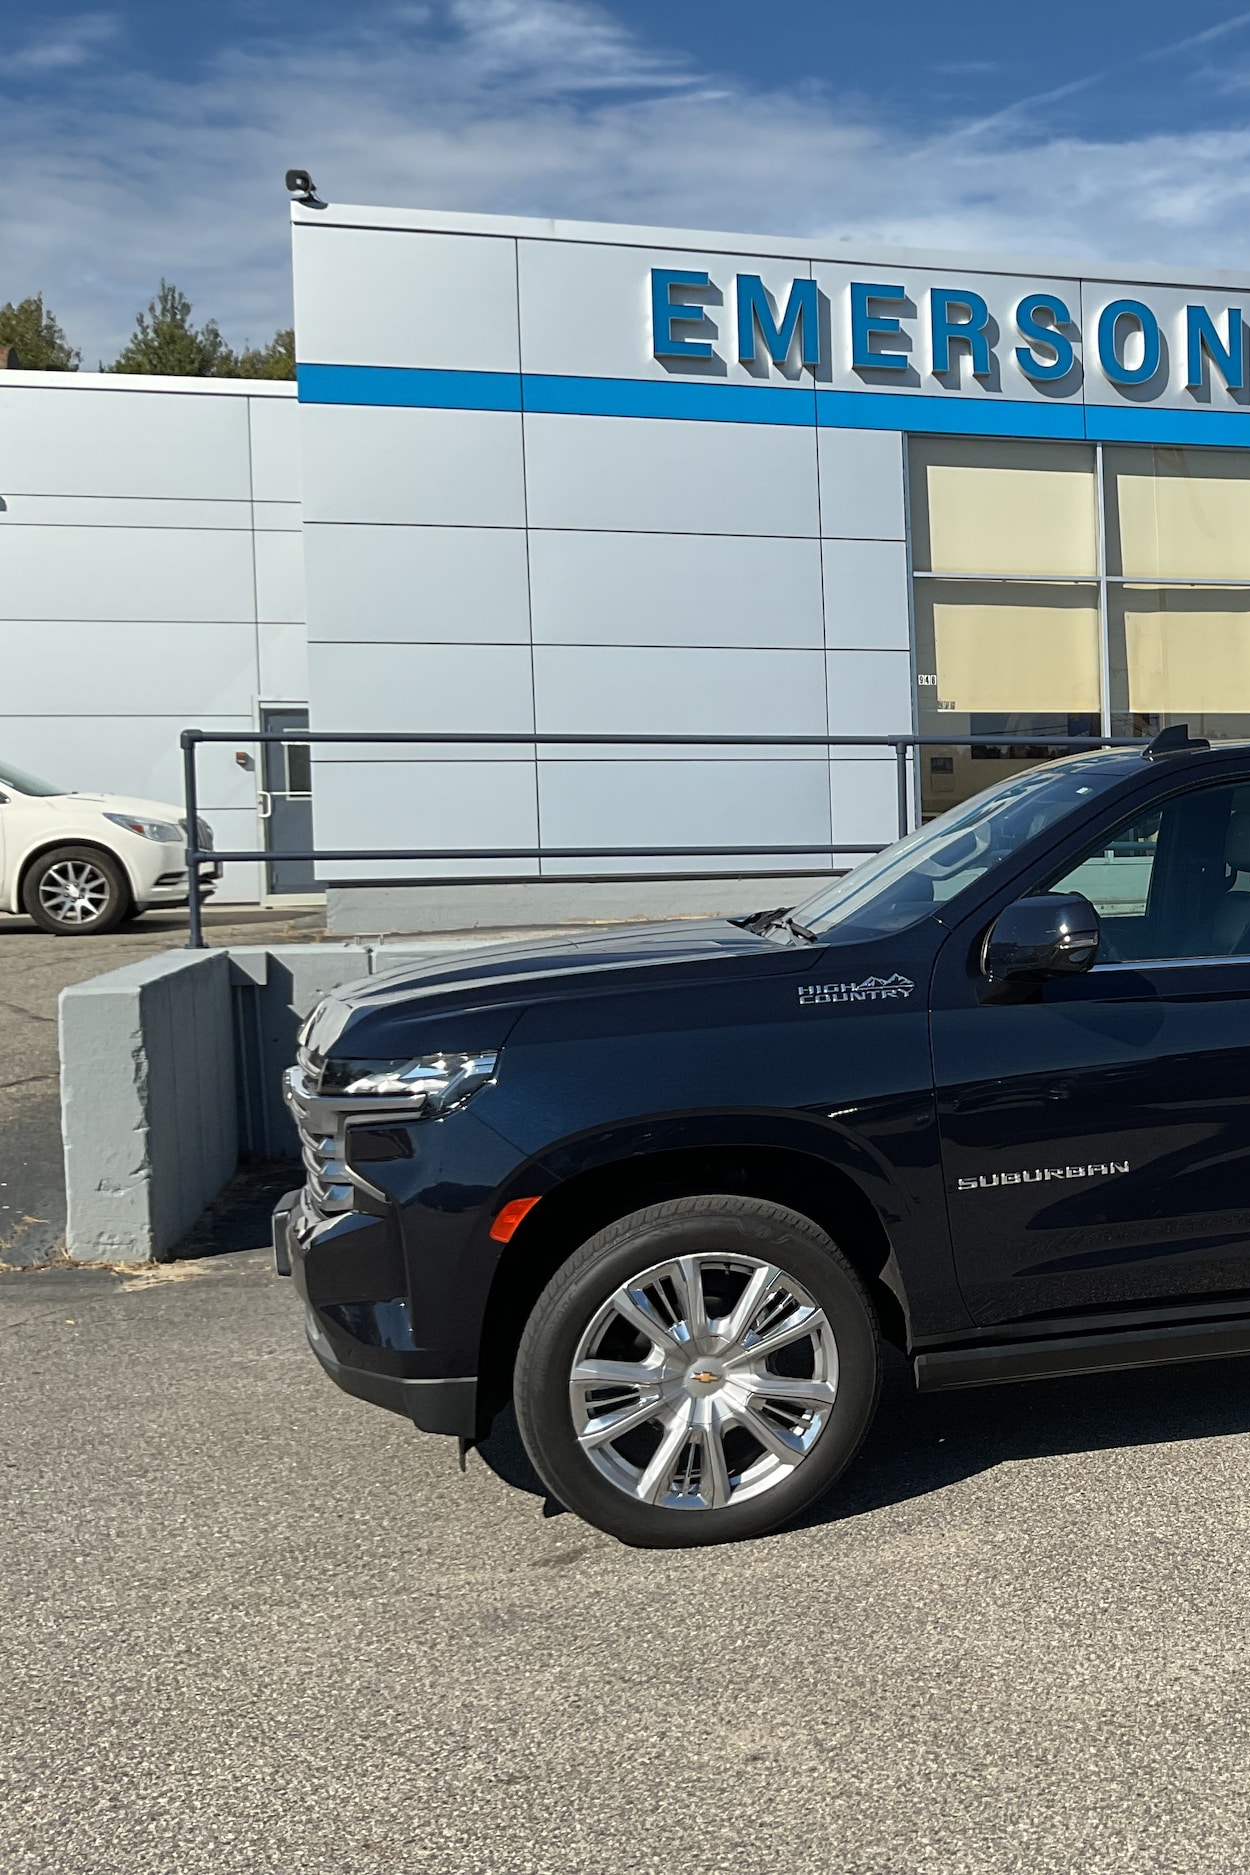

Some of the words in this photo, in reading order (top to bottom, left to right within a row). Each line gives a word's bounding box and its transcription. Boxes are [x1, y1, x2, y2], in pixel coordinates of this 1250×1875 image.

[651, 268, 1243, 391] EMERSON
[798, 982, 857, 995] HIGH
[799, 988, 914, 1004] COUNTRY
[957, 1160, 1130, 1191] SUBURBAN
